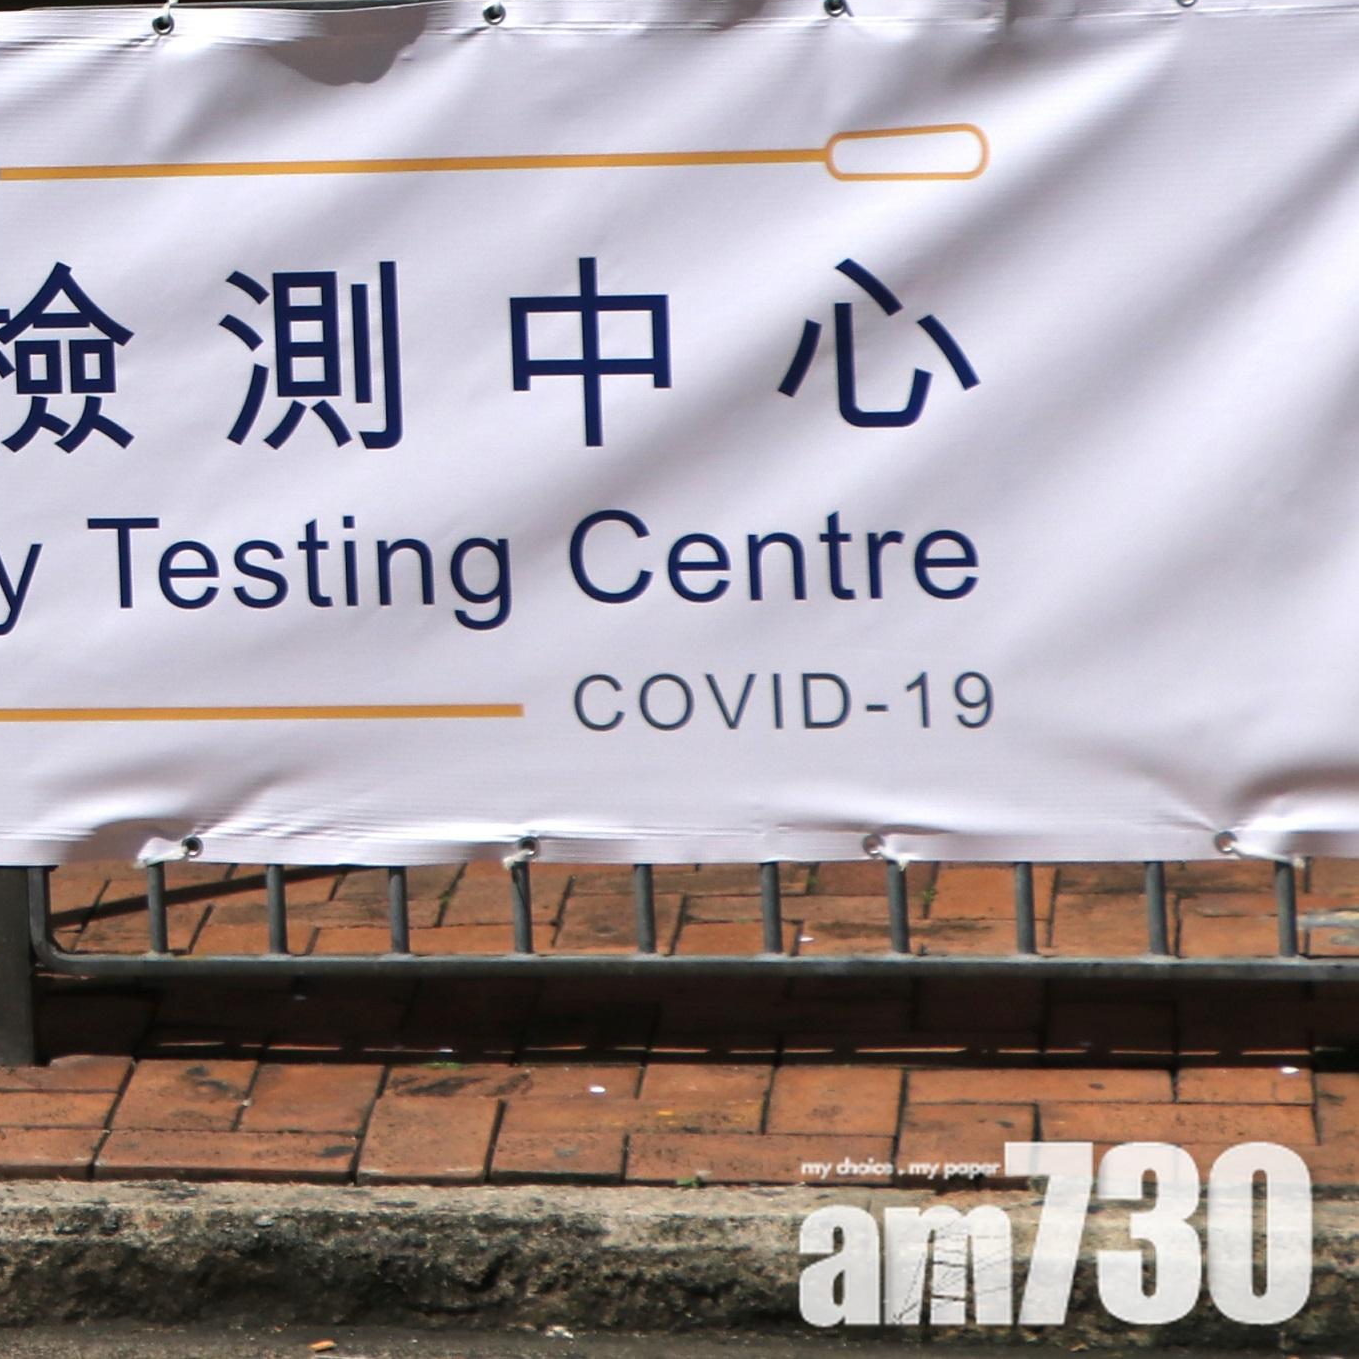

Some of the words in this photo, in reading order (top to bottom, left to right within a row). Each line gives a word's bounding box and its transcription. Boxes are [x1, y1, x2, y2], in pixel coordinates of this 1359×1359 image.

[86, 515, 512, 631] Testing
[568, 509, 981, 604] Centre
[573, 671, 995, 731] COVID-19
